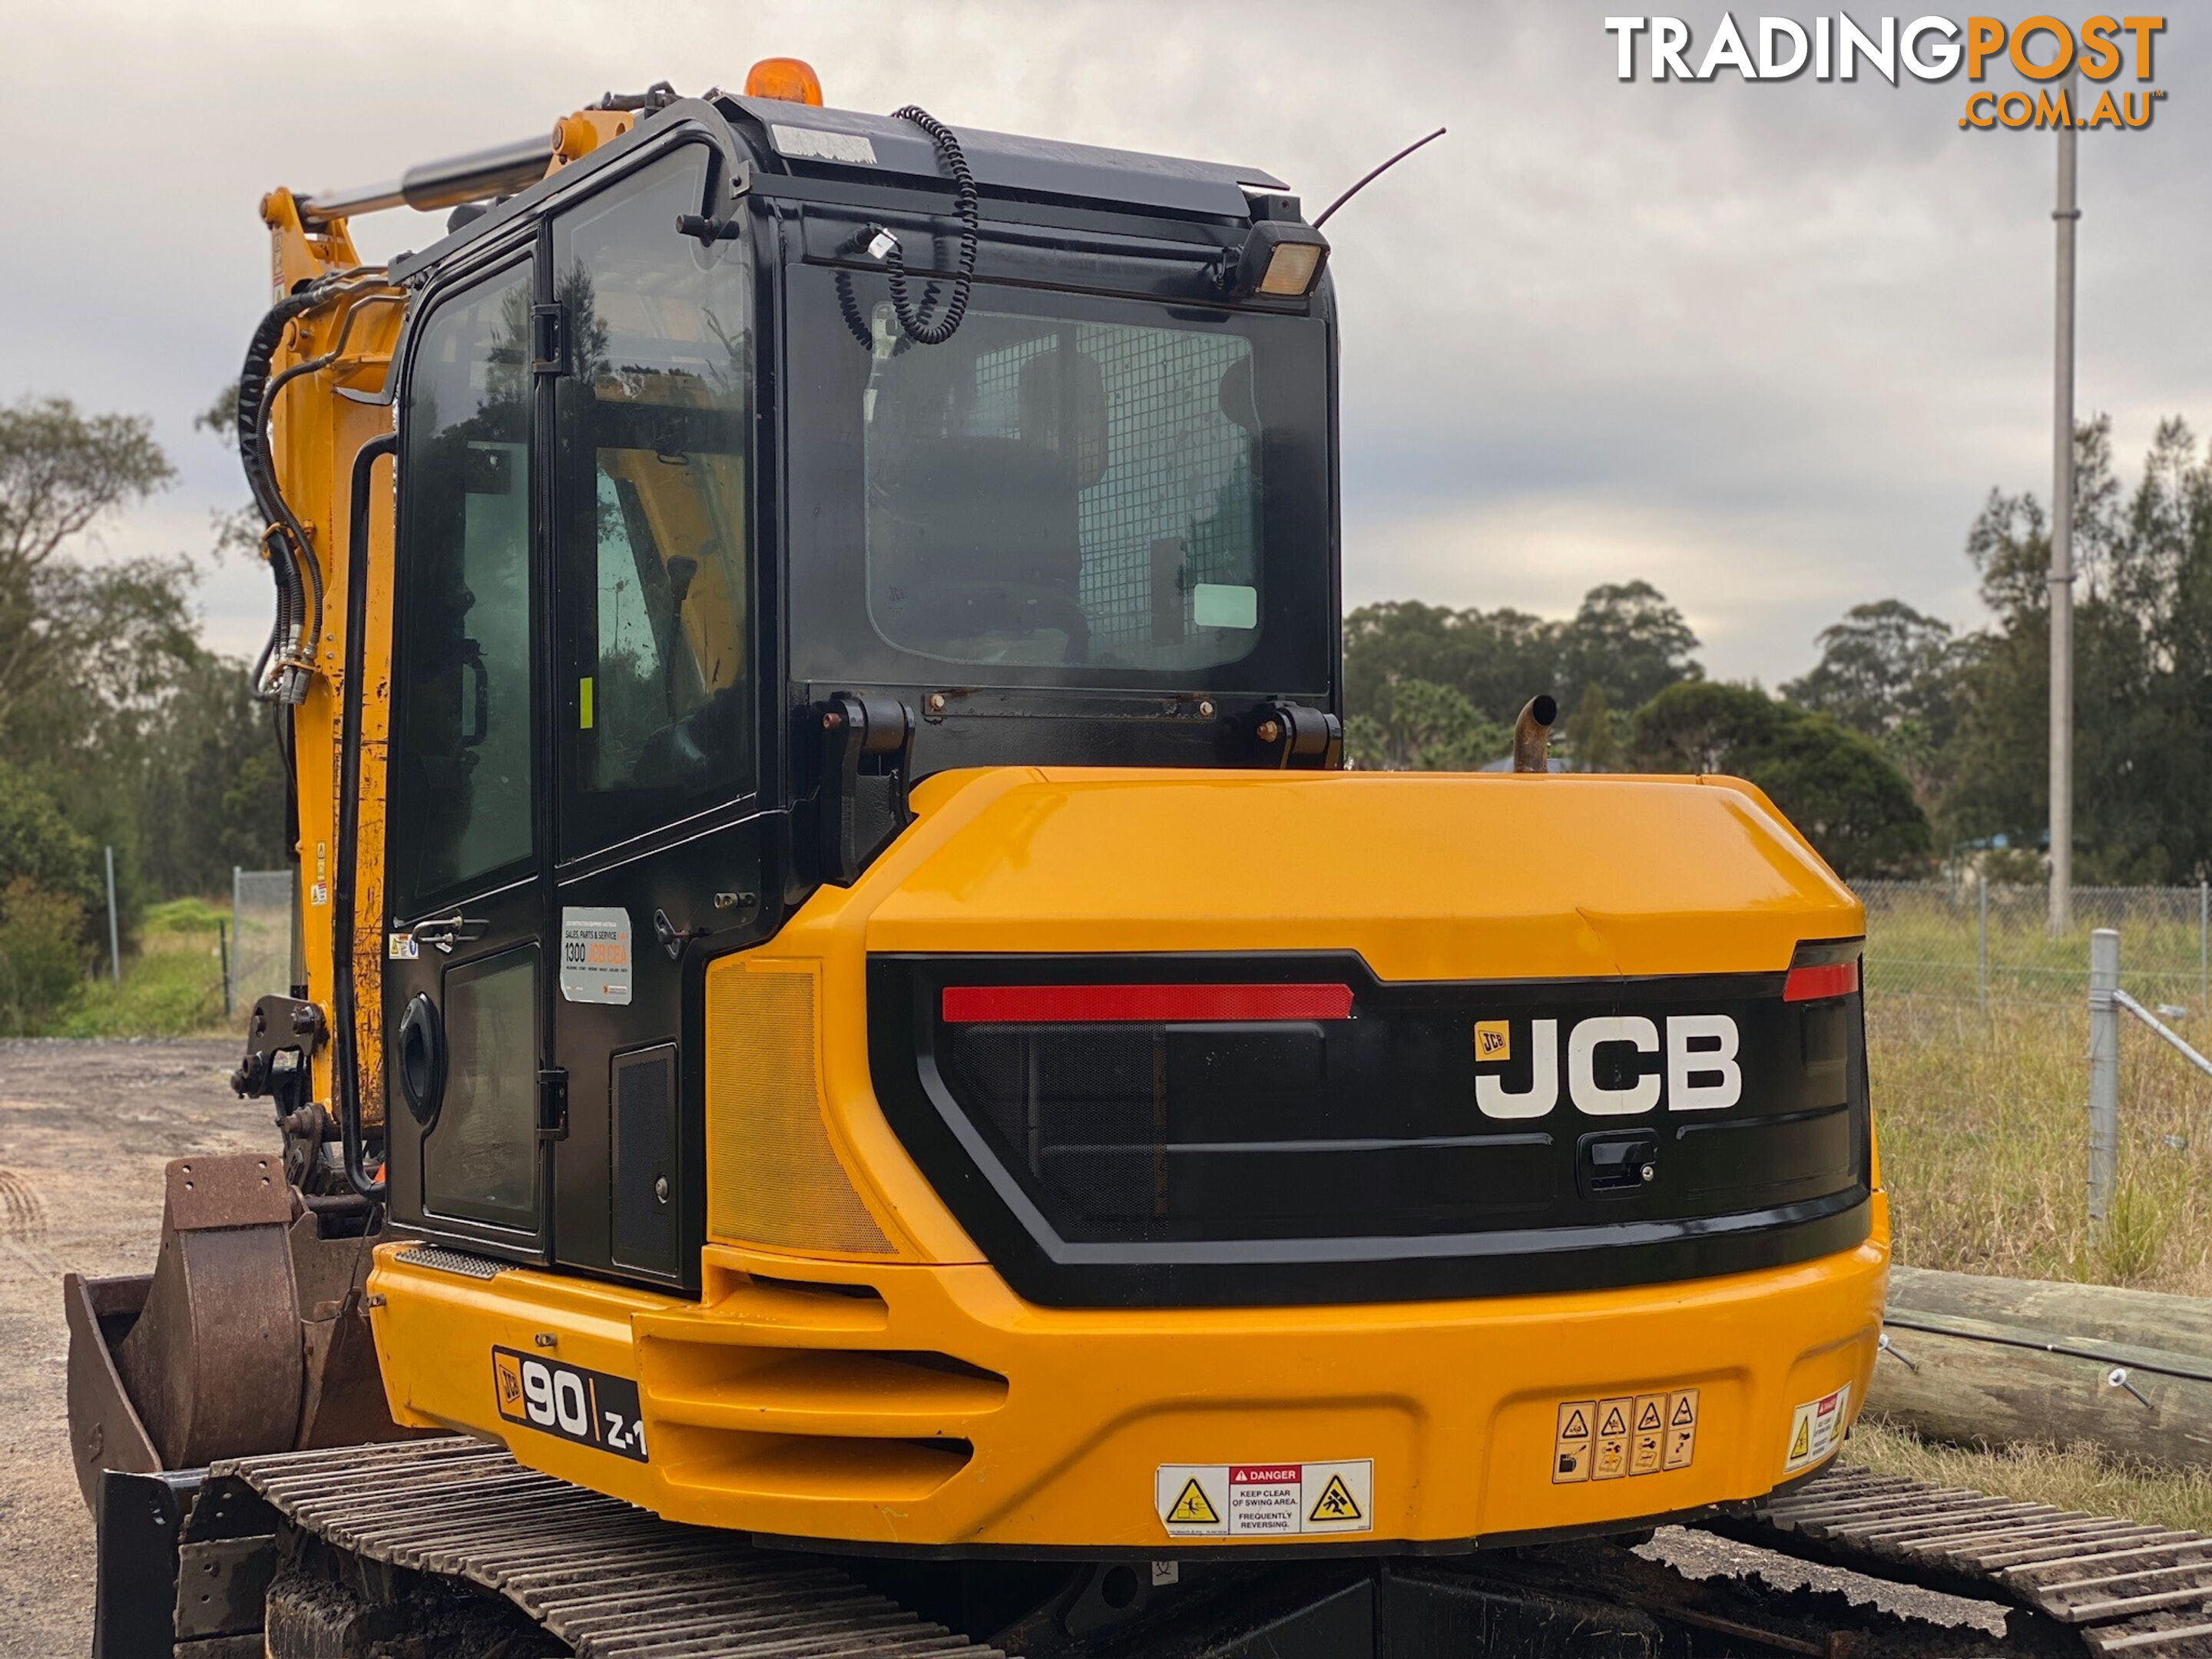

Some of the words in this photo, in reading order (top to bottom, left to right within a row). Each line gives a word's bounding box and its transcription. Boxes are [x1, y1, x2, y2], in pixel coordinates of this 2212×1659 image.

[565, 930, 579, 939] SALES,
[580, 930, 594, 939] PARTS
[598, 931, 617, 940] SERVICE
[565, 942, 585, 962] 1300
[588, 943, 605, 963] JCB
[1483, 1032, 1504, 1051] JCB
[1475, 1015, 1742, 1119] JCB
[503, 1369, 519, 1399] JCB
[522, 1360, 588, 1436] 90
[1250, 1470, 1296, 1480] DANGER
